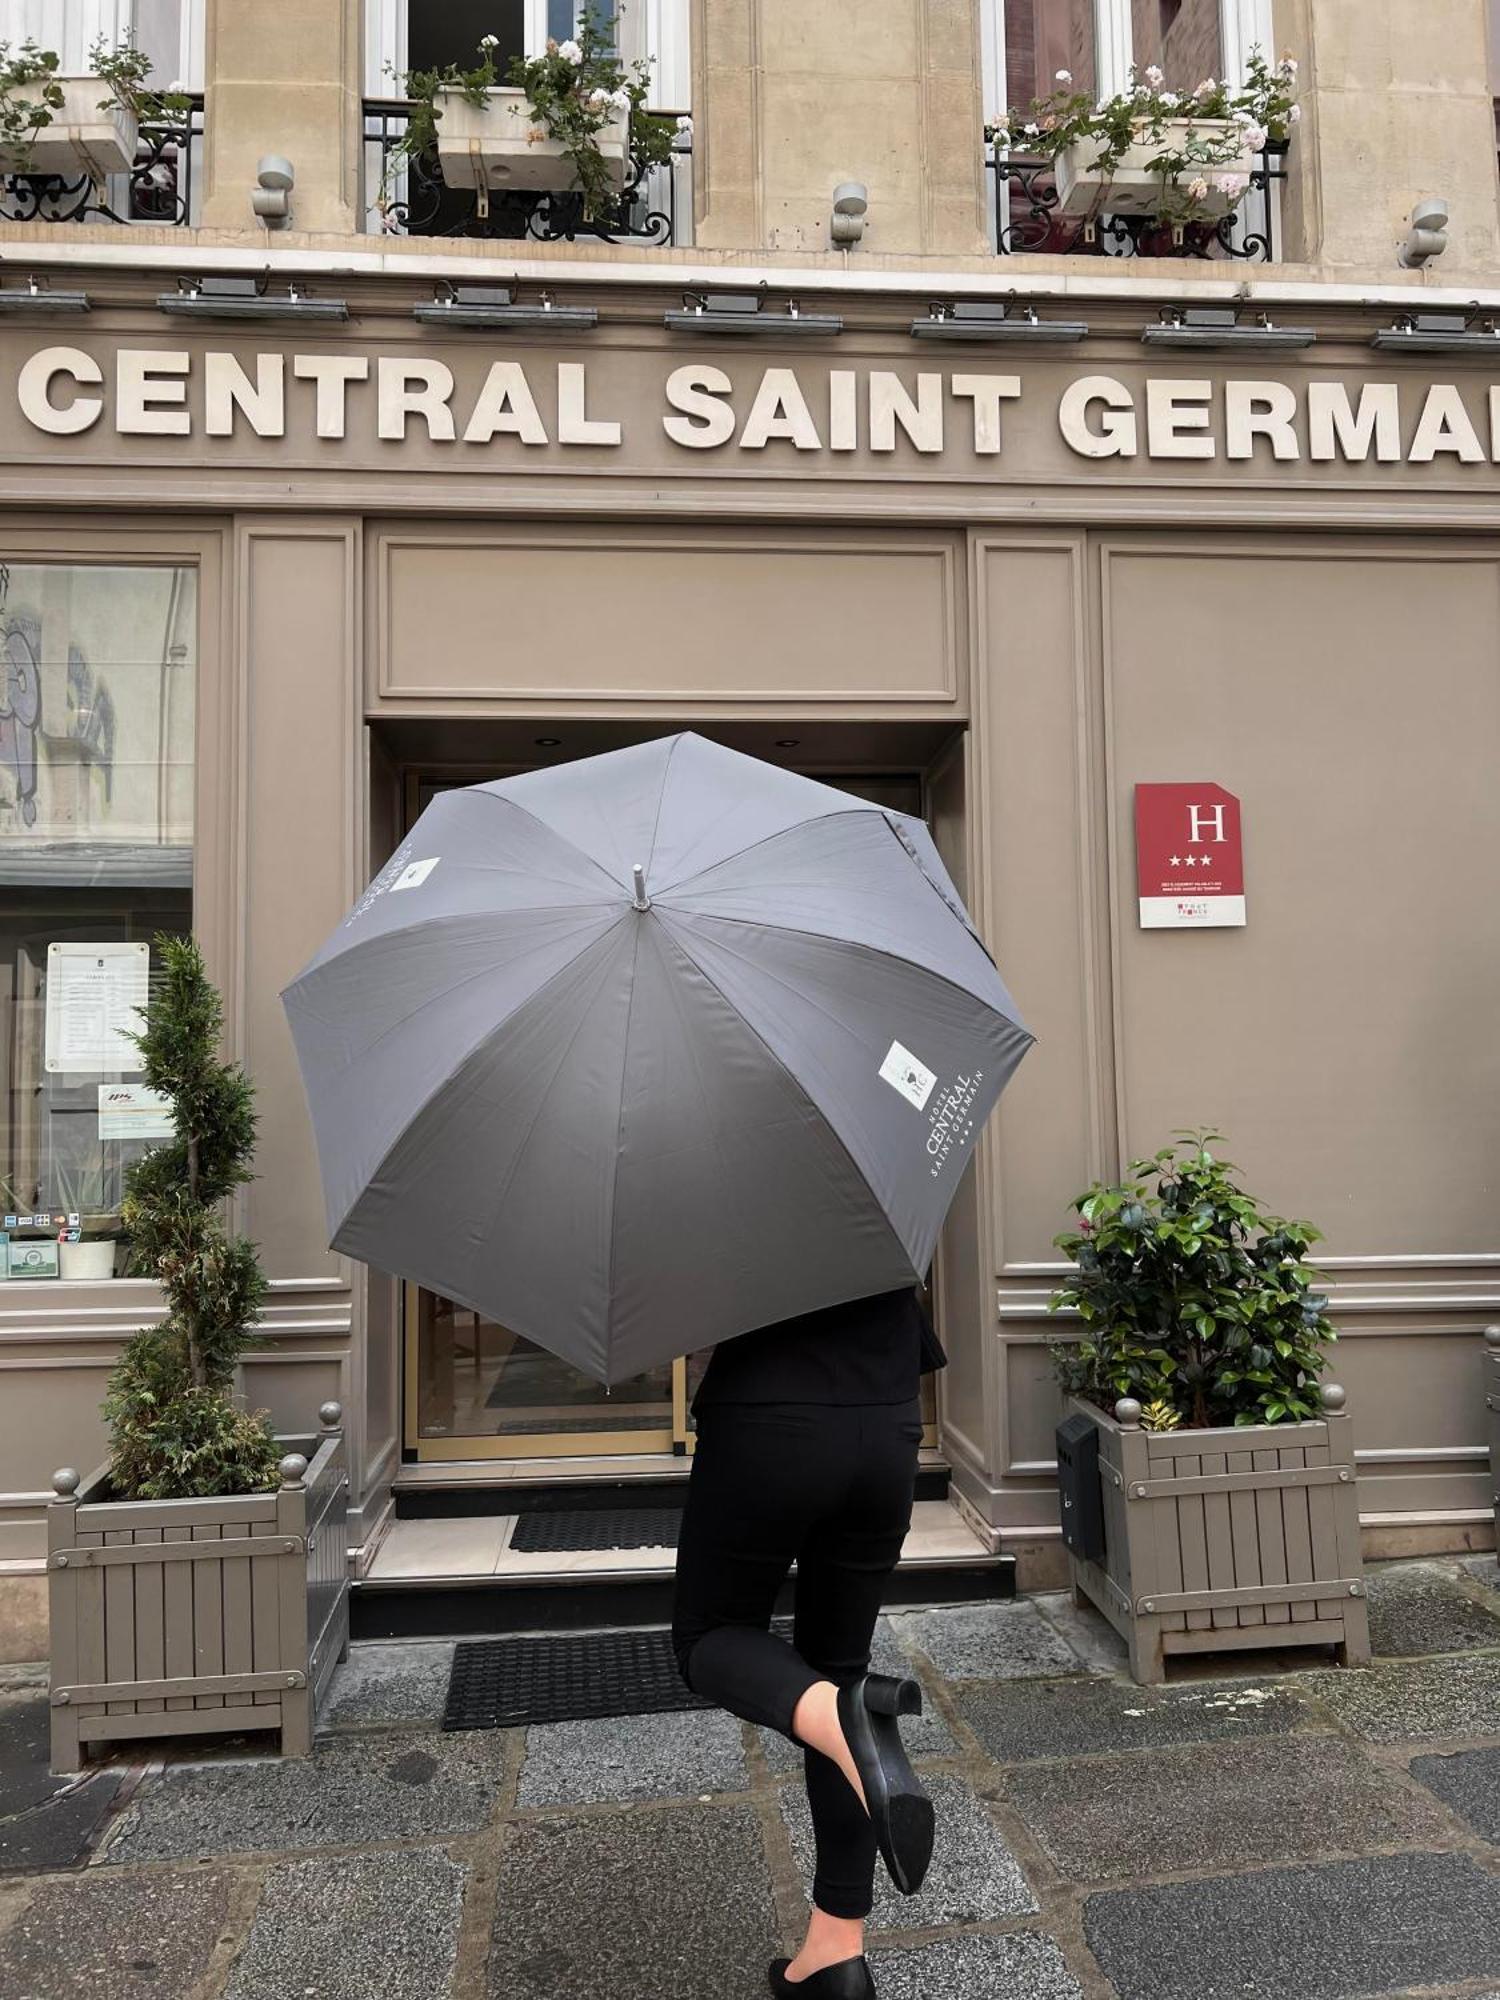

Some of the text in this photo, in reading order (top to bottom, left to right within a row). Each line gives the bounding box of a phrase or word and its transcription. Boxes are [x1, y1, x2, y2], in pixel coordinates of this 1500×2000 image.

[17, 346, 622, 445] CENTRAL
[662, 364, 1021, 454] SAINT
[1186, 804, 1228, 842] H
[926, 1074, 971, 1155] CENTRAL
[929, 1087, 950, 1124] HOTEL
[931, 1070, 984, 1177] SAINT GERMAIN
